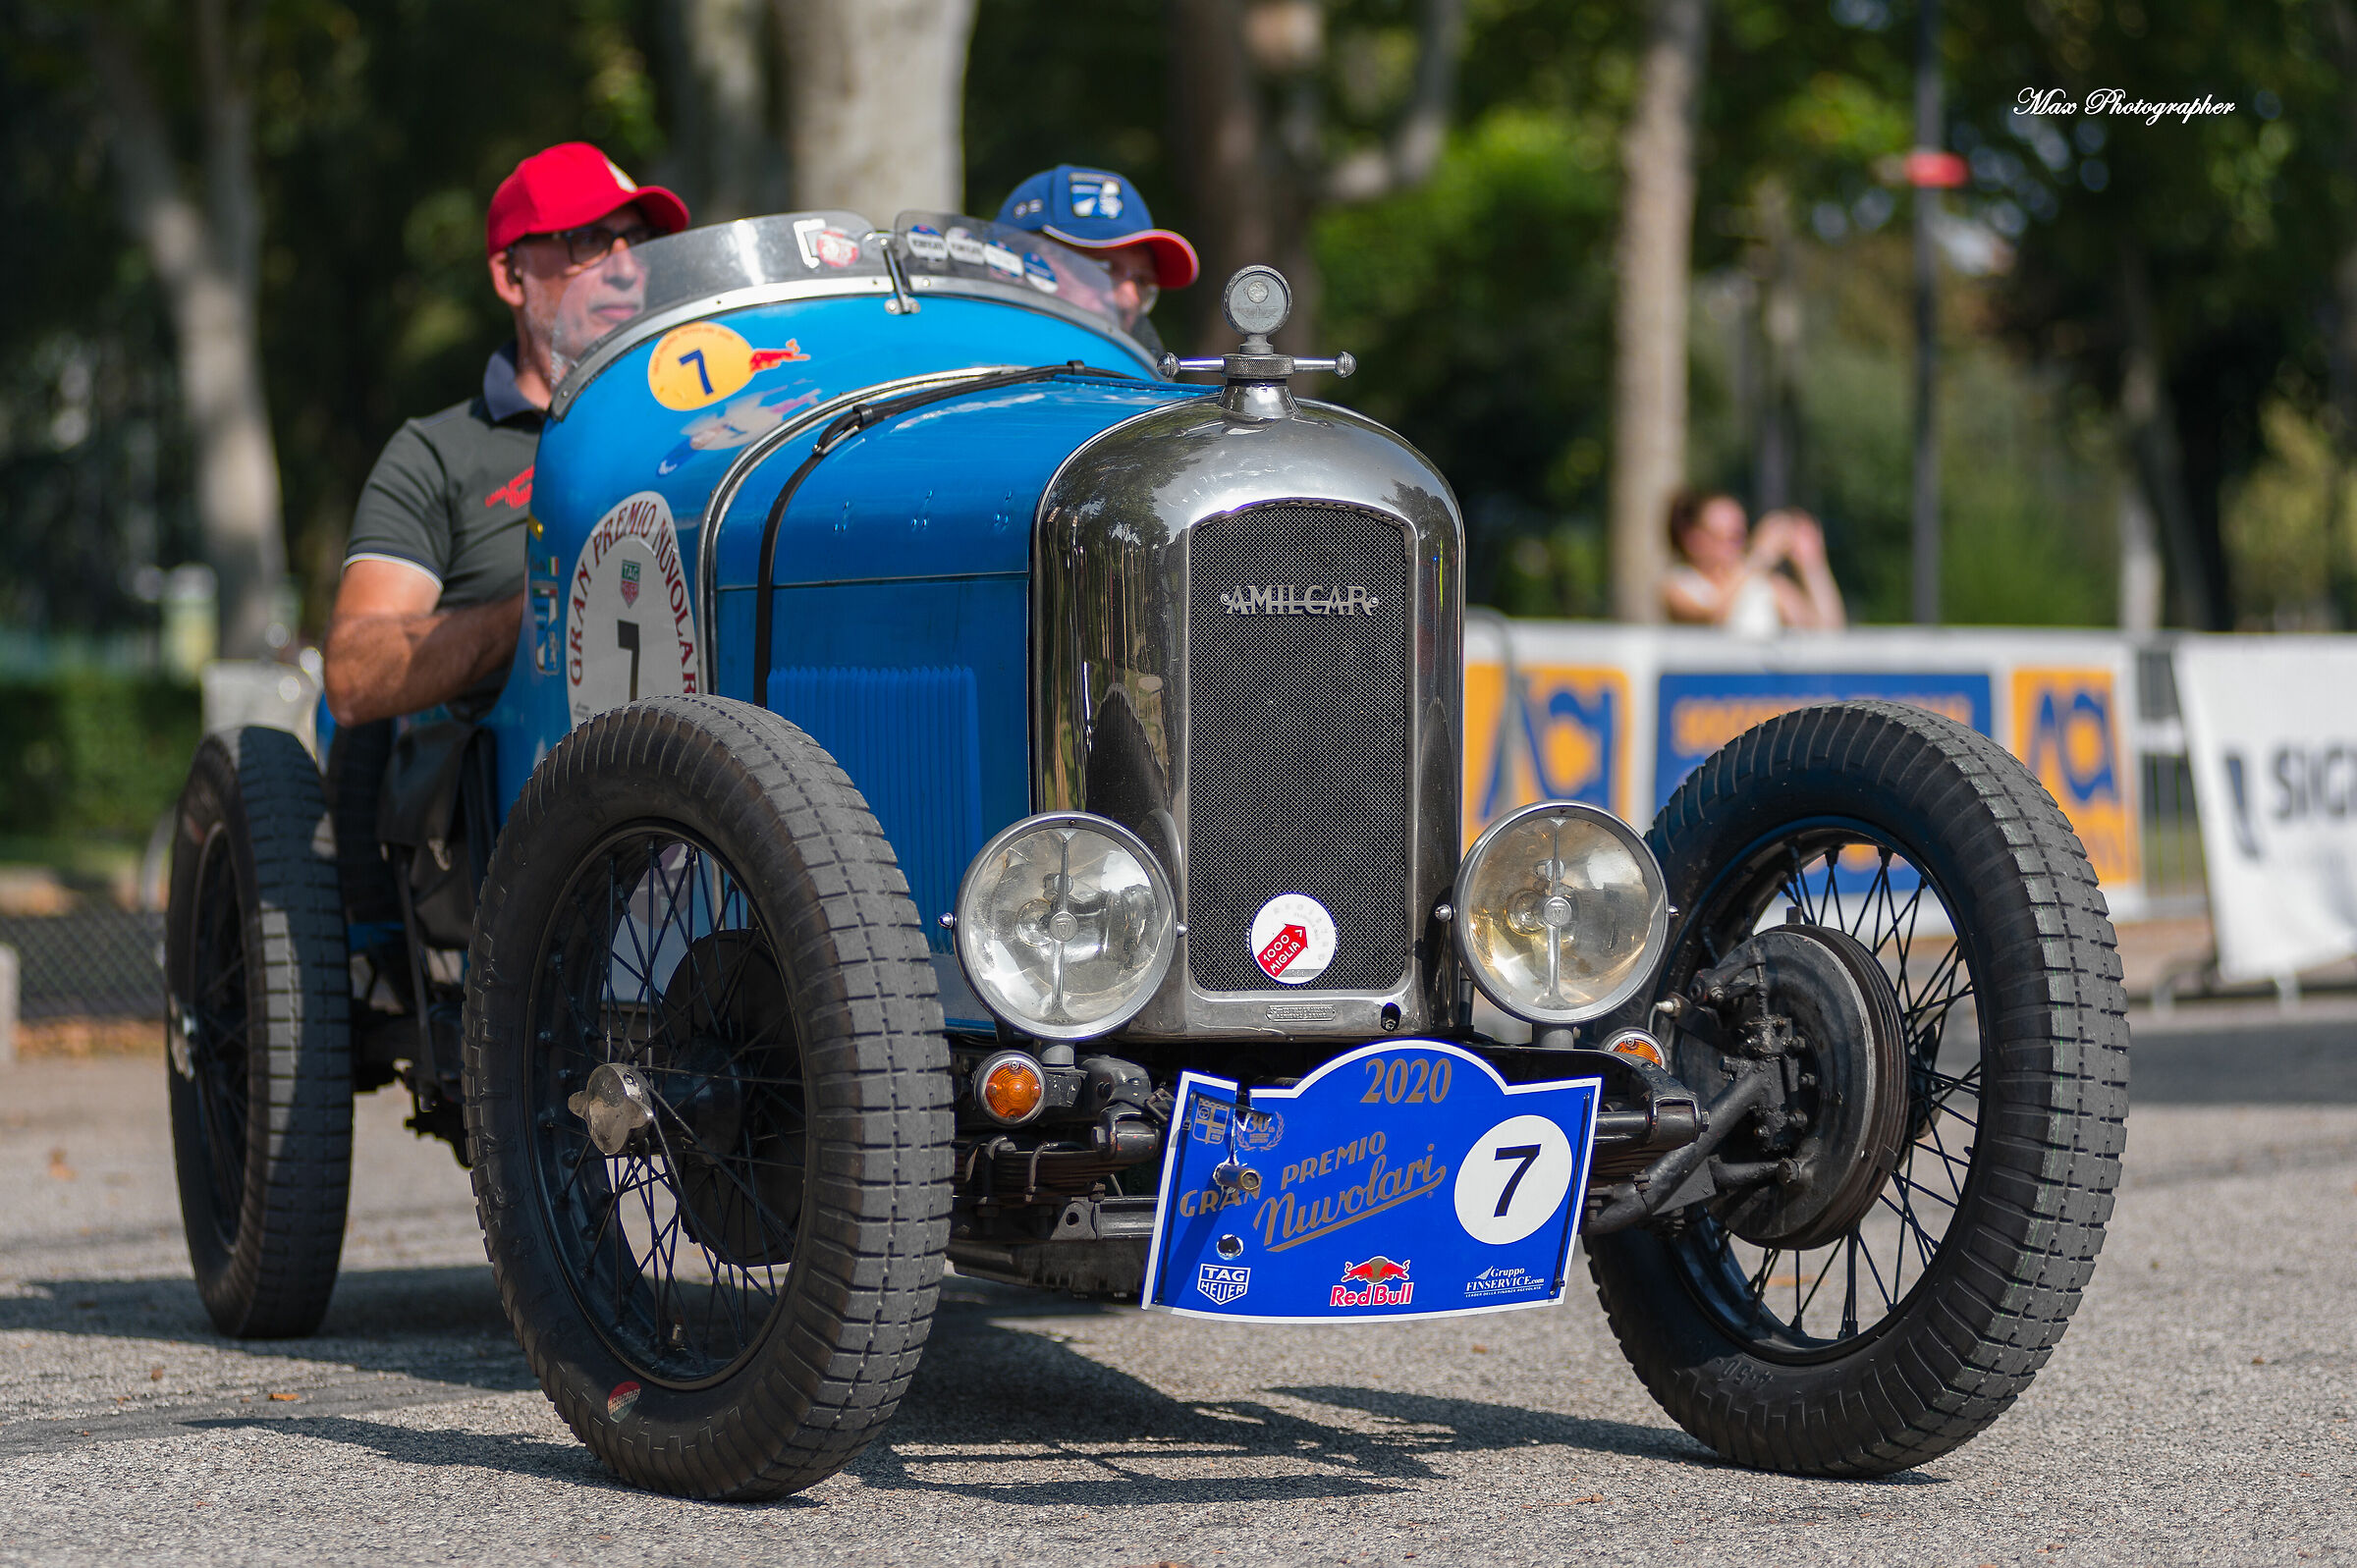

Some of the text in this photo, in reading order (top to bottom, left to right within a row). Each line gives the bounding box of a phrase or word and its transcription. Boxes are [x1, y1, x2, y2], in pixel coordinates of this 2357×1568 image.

[679, 350, 714, 396] 7
[592, 501, 657, 568] PREMIO
[652, 518, 696, 694] NUVOLAR
[1227, 585, 1373, 616] AMILCAR
[1263, 934, 1290, 962] 1000
[1270, 941, 1301, 974] MIGLIA
[1361, 1058, 1452, 1104] 2020
[1281, 1130, 1387, 1191] PREMIO
[1253, 1143, 1447, 1247] Nuvolari
[1493, 1144, 1542, 1218] 7
[1205, 1268, 1245, 1281] TAG
[1491, 1268, 1525, 1277] Gruppo
[1200, 1281, 1244, 1302] HEUER
[1330, 1282, 1414, 1307] Red Bull
